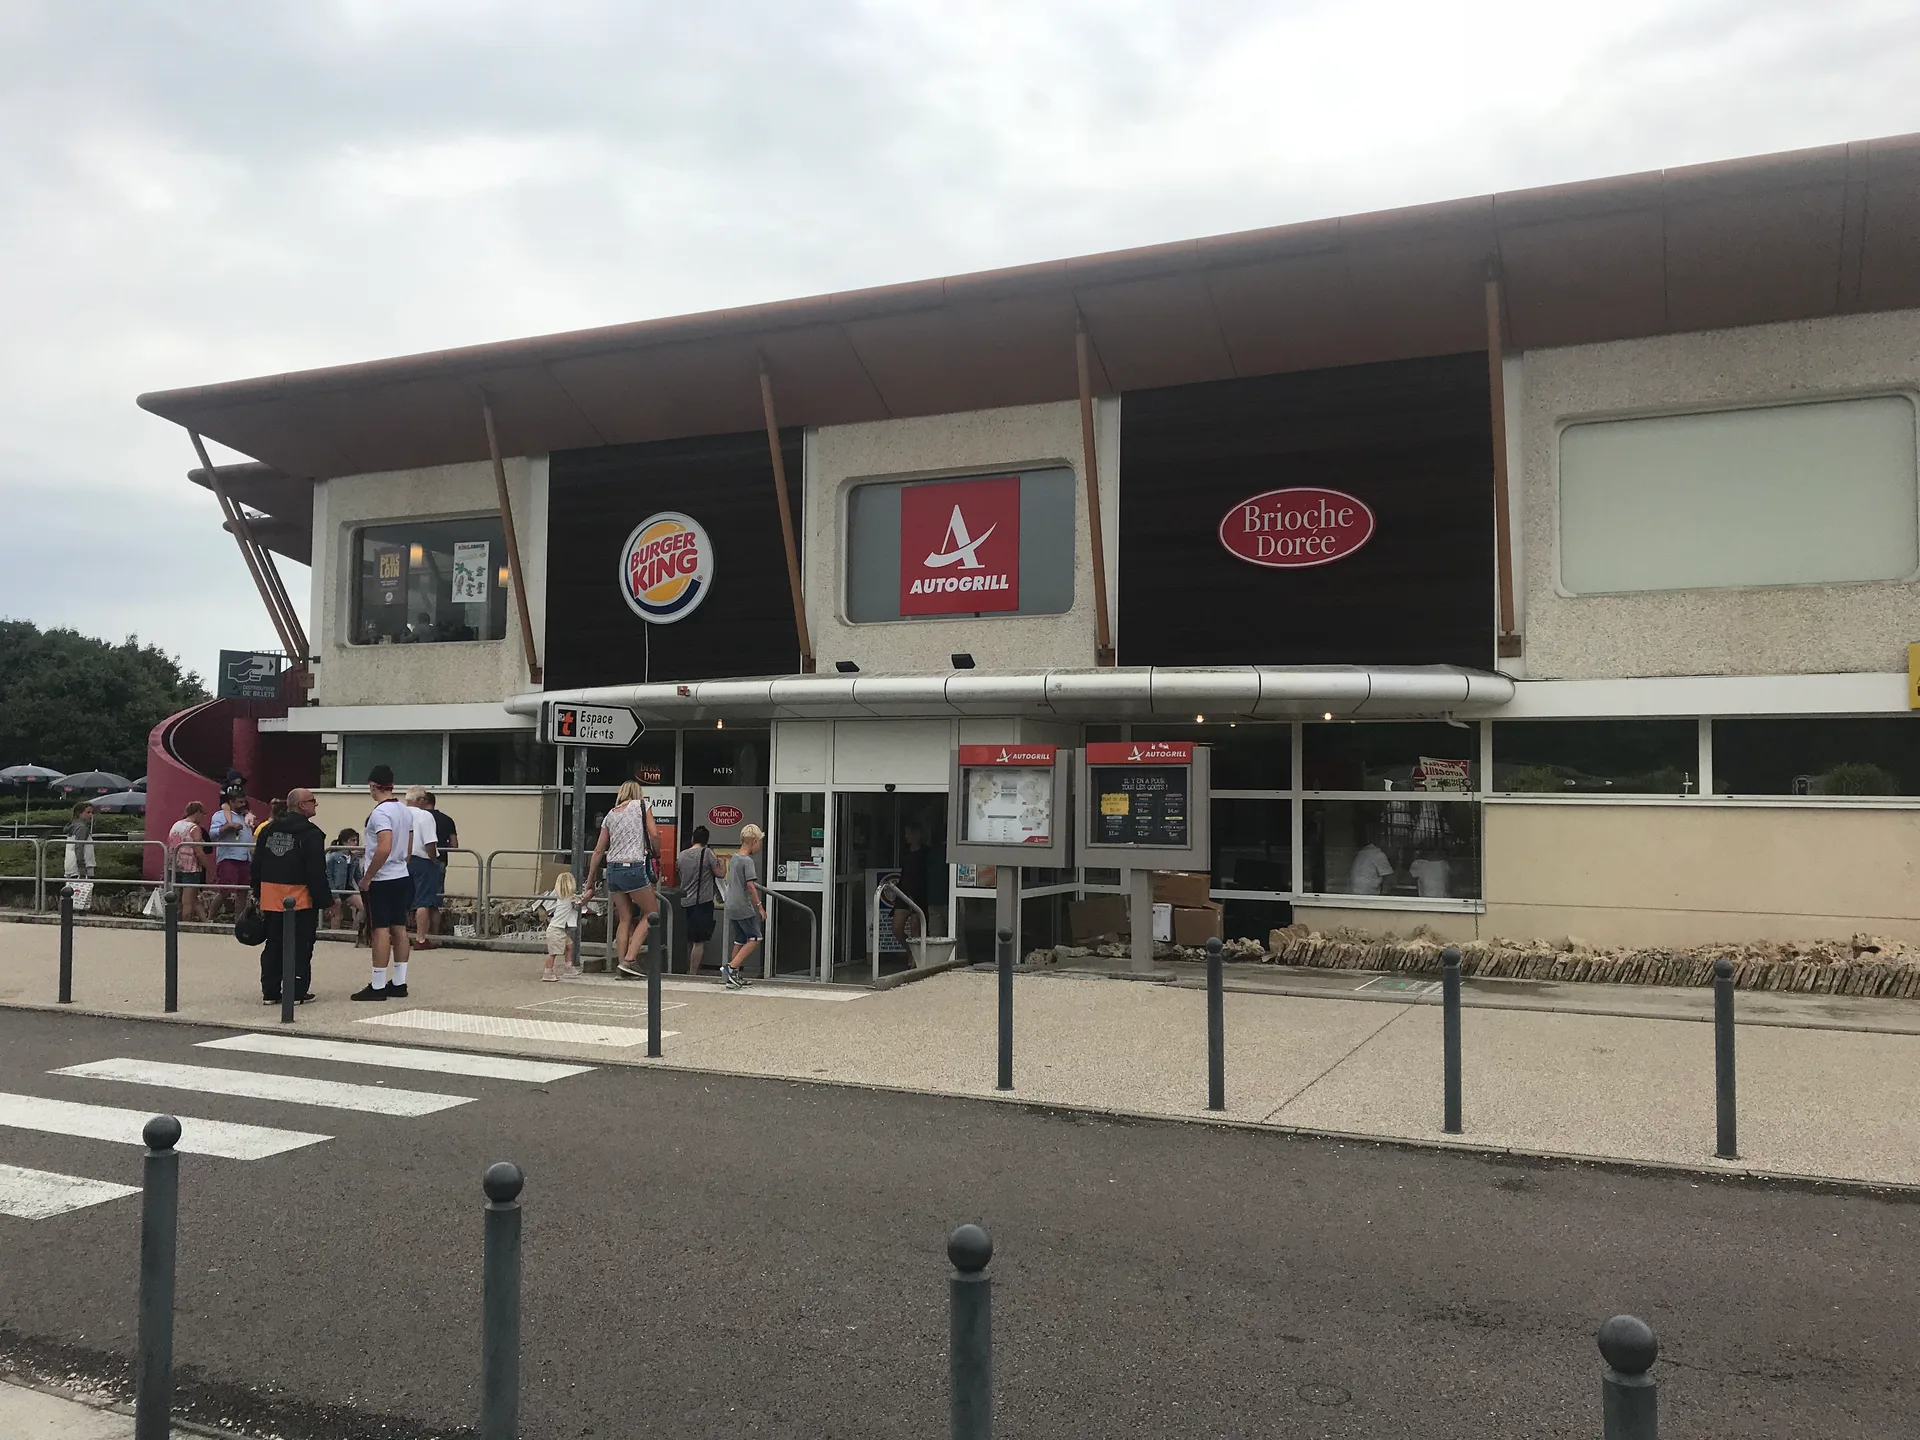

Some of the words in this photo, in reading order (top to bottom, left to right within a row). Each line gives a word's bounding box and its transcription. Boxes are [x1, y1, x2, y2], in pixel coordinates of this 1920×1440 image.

[1243, 499, 1354, 533] Brioche
[630, 532, 696, 572] BURGER
[1256, 528, 1336, 557] Dorée
[632, 548, 698, 598] KING
[909, 574, 1009, 595] AUTOGRILL
[252, 690, 275, 698] BILLETS
[580, 710, 613, 726] Espace
[651, 799, 673, 808] APRR
[712, 808, 740, 818] Brioche
